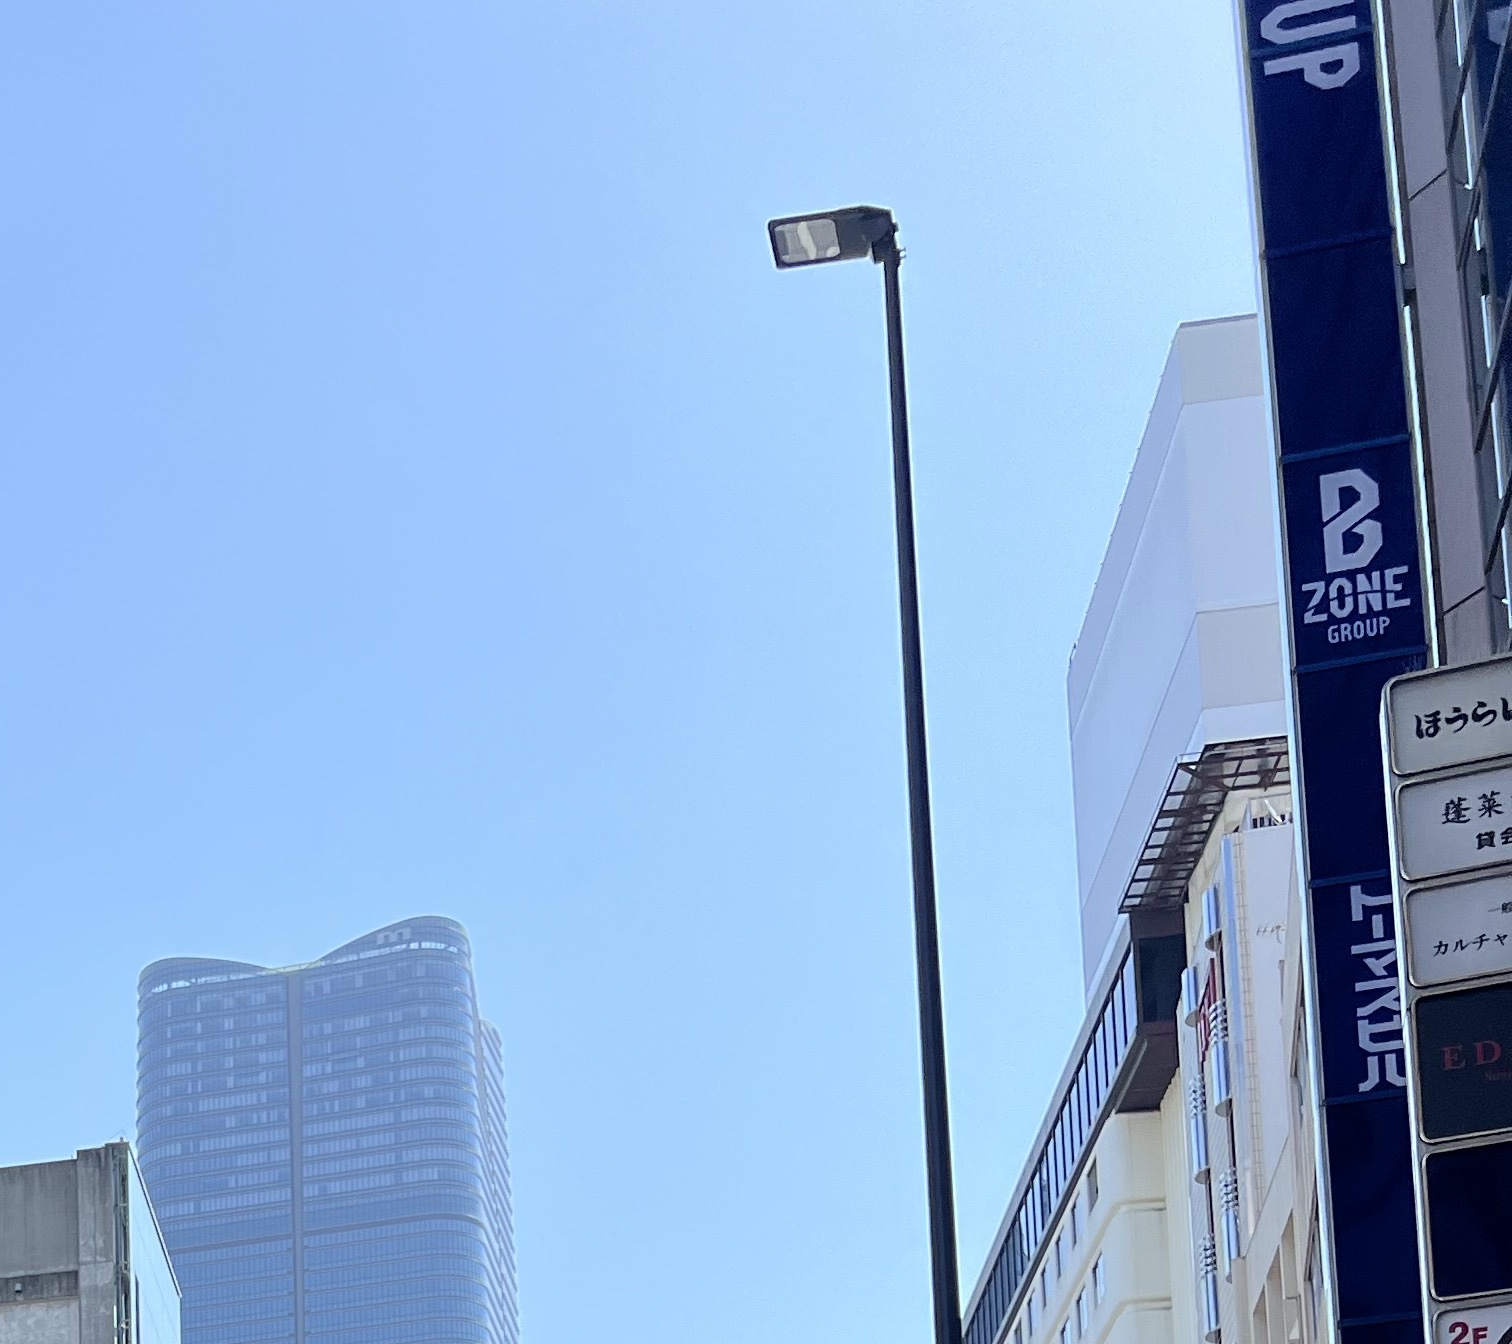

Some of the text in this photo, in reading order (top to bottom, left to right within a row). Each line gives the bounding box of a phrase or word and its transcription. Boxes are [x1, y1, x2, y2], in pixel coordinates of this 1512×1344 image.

[1319, 468, 1383, 574] B
[1302, 565, 1411, 624] ZONE
[1327, 616, 1390, 644] GROUP
[1442, 791, 1512, 825] 蓬莱
